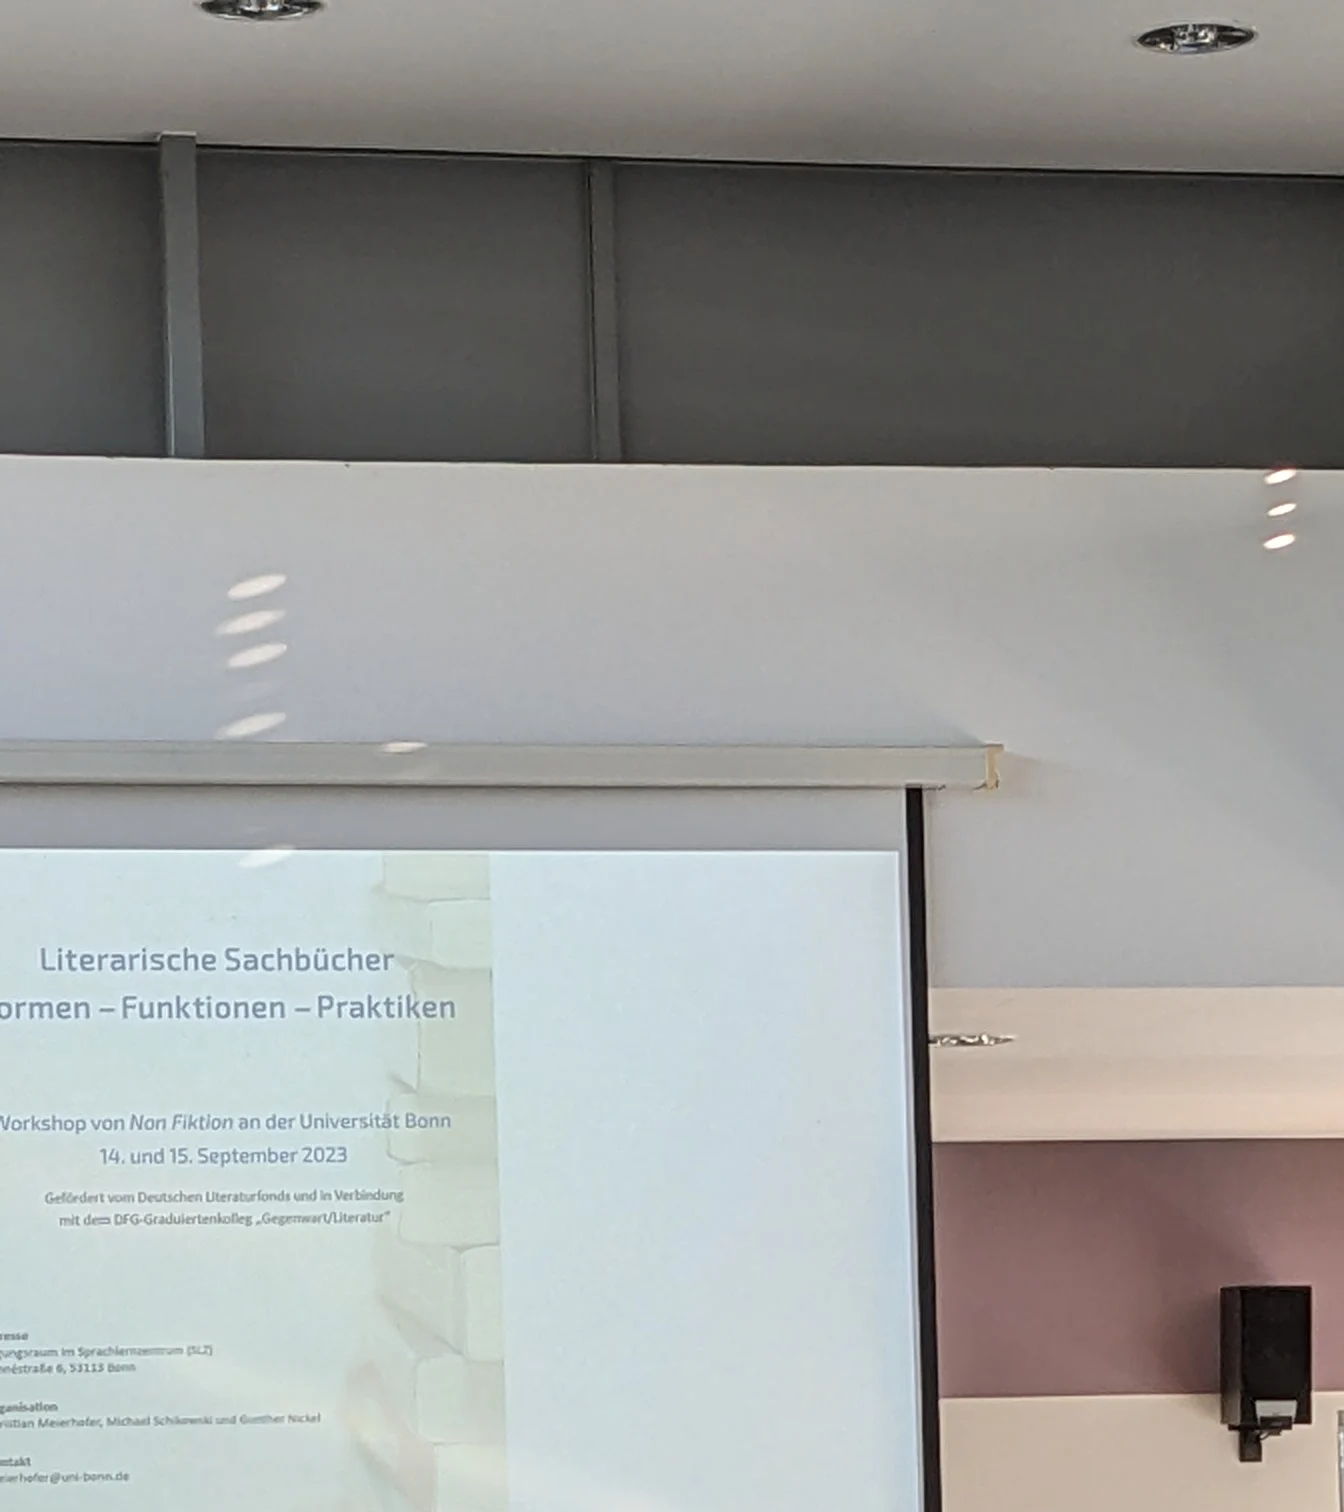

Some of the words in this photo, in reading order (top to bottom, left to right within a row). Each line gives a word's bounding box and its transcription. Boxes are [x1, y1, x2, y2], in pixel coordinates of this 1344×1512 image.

[40, 947, 217, 972] Literarische
[225, 947, 394, 972] Sachbücher
[121, 995, 286, 1020] Funktionen
[317, 994, 456, 1019] Praktiken
[91, 1118, 125, 1131] von
[129, 1114, 167, 1131] Non
[171, 1113, 234, 1131] Fiktion
[238, 1117, 261, 1130] an
[265, 1114, 296, 1130] der
[300, 1112, 400, 1130] Universität
[405, 1112, 451, 1129] Bonn
[100, 1148, 125, 1165] 14.
[130, 1148, 164, 1165] und
[169, 1148, 193, 1165] 15.
[197, 1147, 297, 1168] September
[302, 1147, 348, 1164] 2023
[44, 1191, 104, 1205] Gefördert
[107, 1194, 135, 1204] vom
[137, 1191, 203, 1204] Deutschen
[205, 1190, 291, 1203] Literaturfonds
[293, 1189, 317, 1202] und
[319, 1190, 332, 1202] in
[334, 1189, 405, 1204] Verbindung
[59, 1214, 80, 1226] mit
[114, 1212, 253, 1227] DFG-Graduiertenkolleg
[107, 1363, 136, 1373] Bonn
